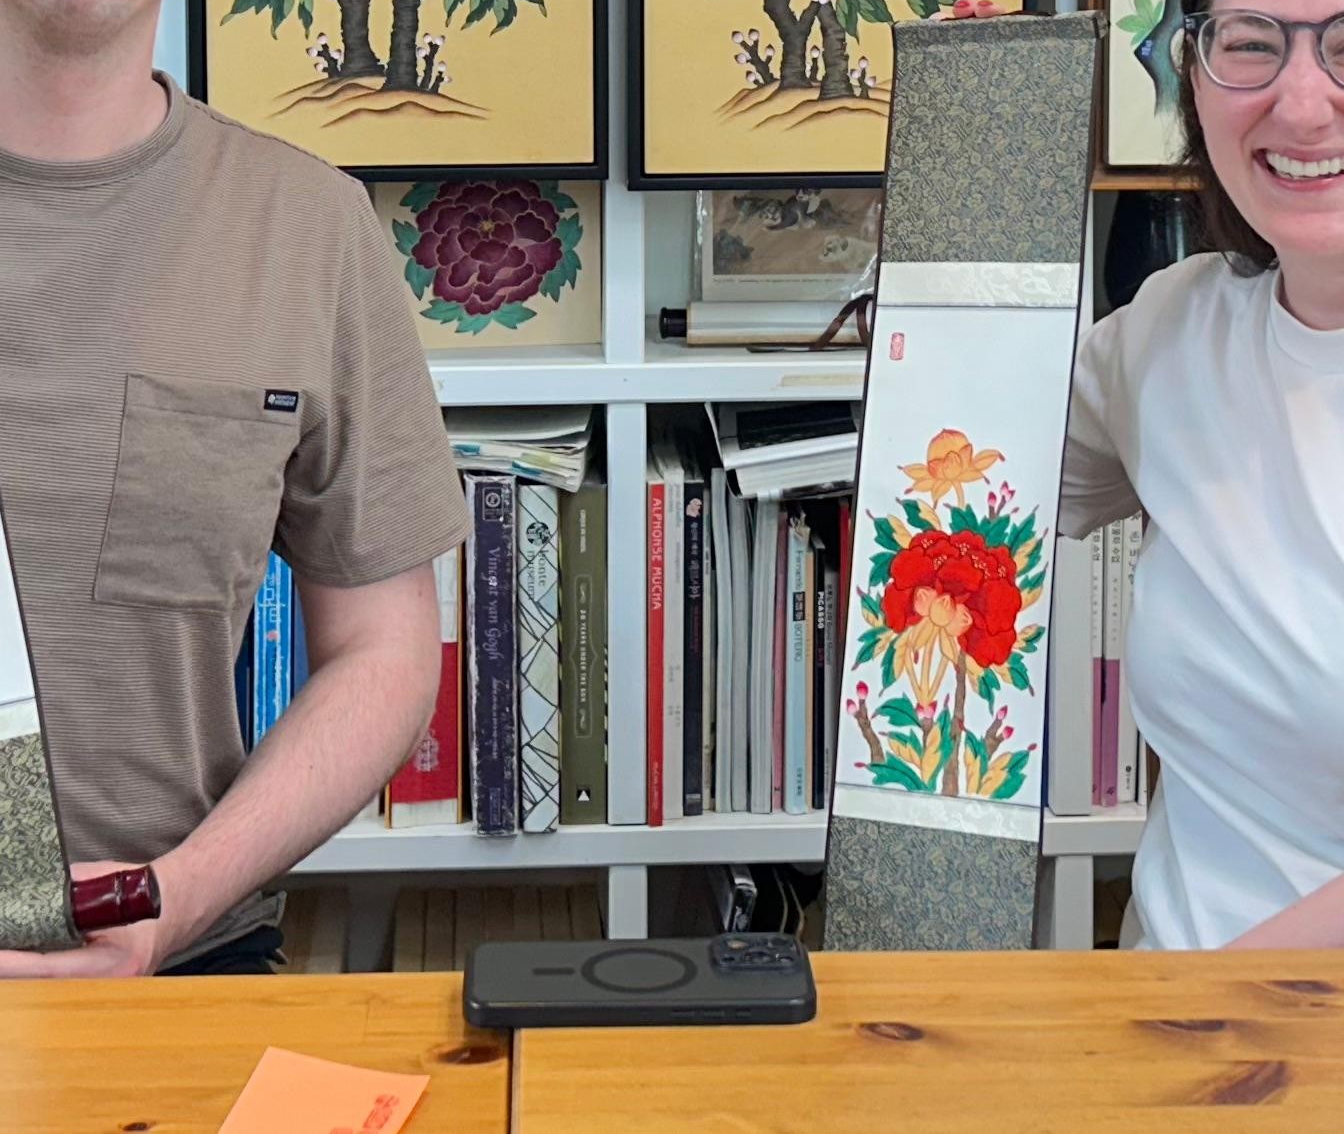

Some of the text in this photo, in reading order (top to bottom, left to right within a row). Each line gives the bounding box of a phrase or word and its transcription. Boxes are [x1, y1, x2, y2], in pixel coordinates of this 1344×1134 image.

[650, 497, 662, 610] ALPHONSE MUCHA
[487, 600, 500, 624] van
[479, 628, 501, 661] Gogh
